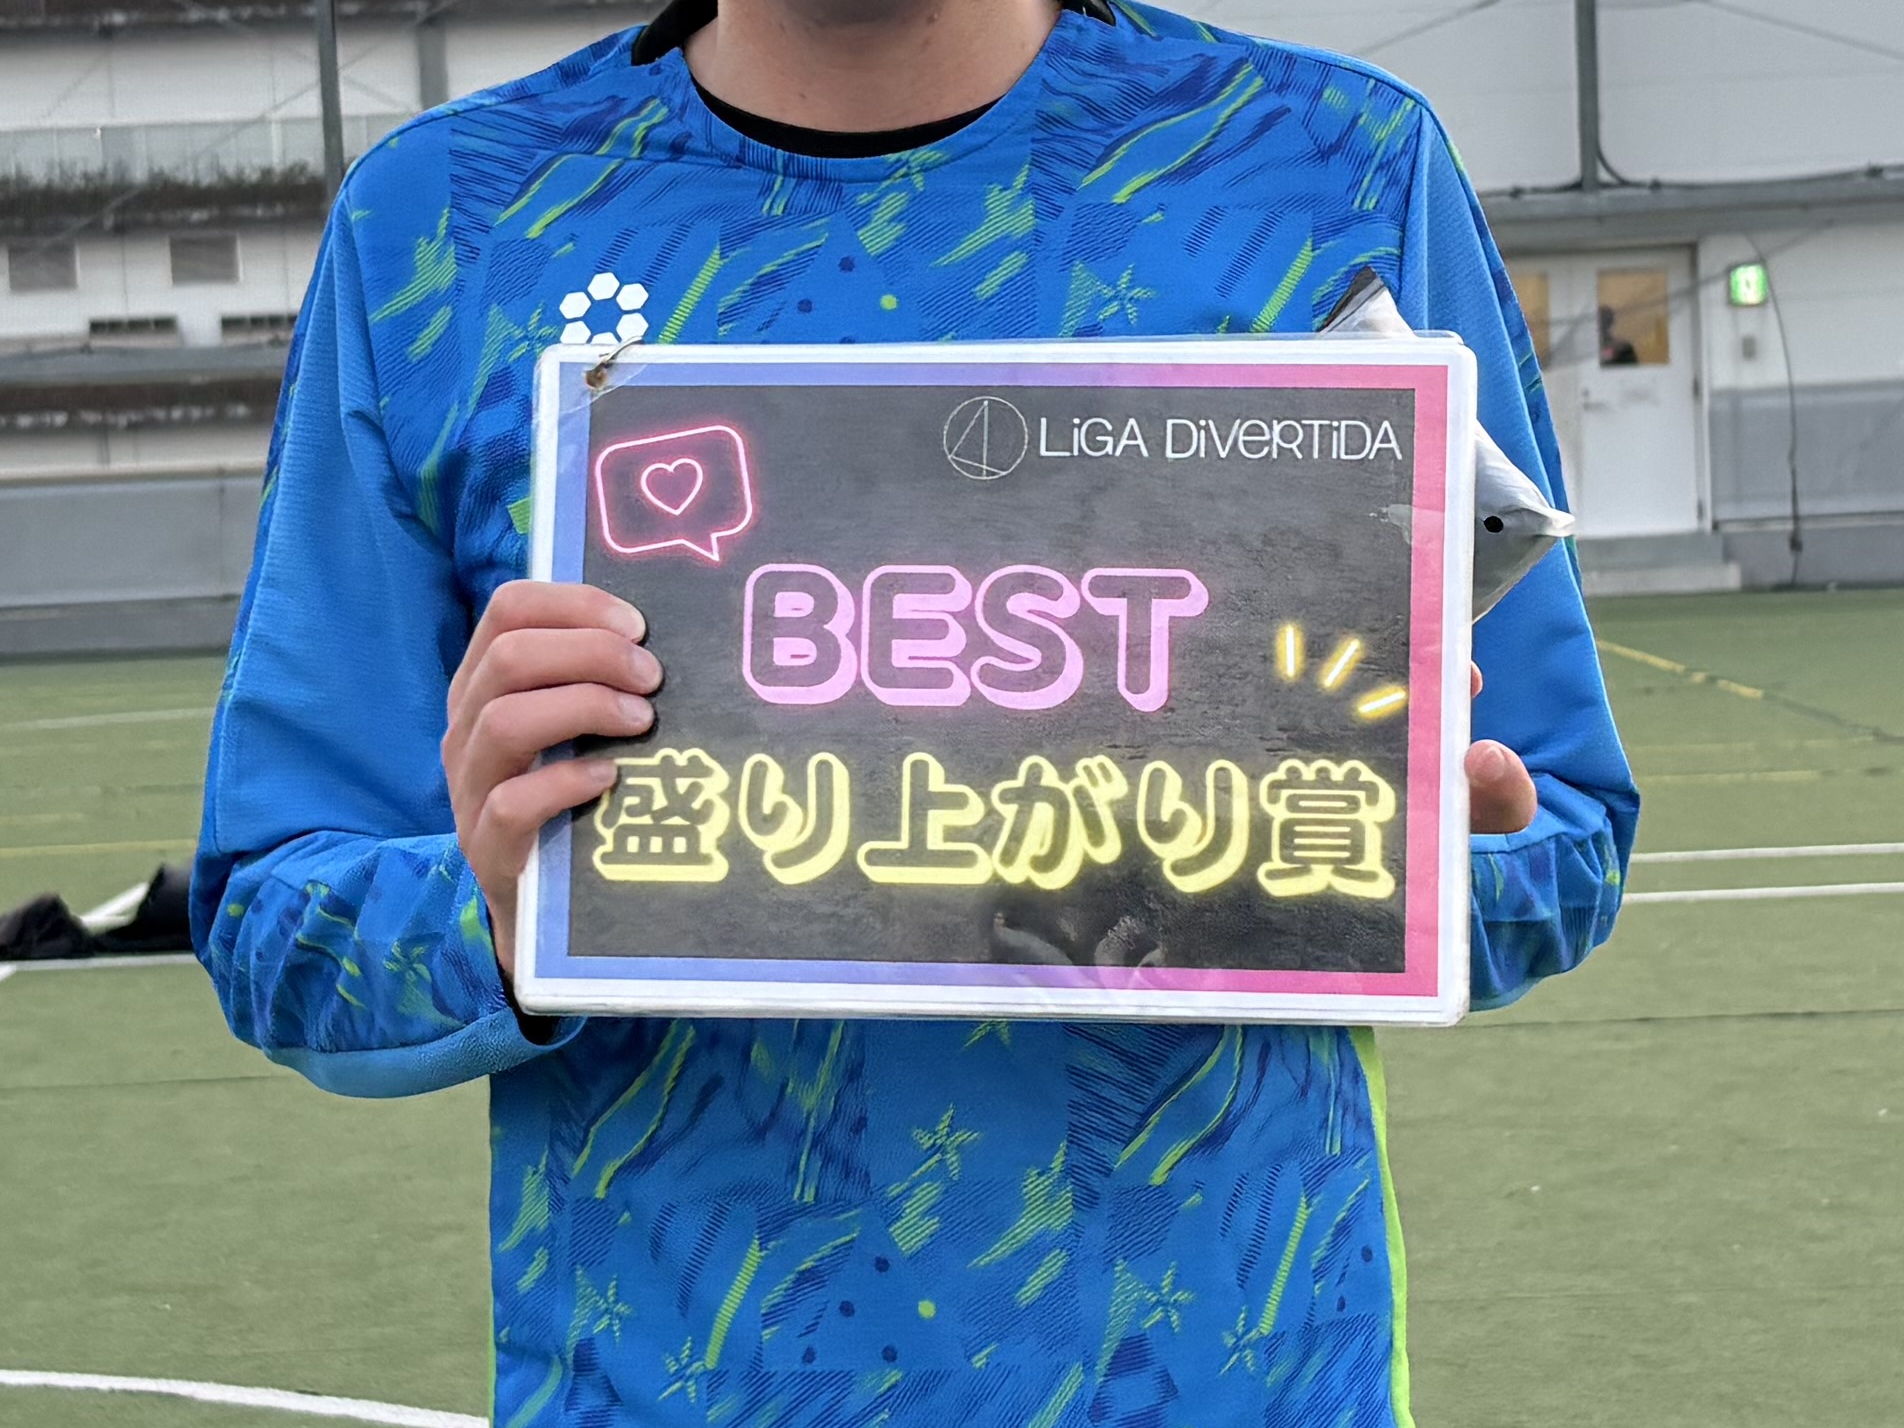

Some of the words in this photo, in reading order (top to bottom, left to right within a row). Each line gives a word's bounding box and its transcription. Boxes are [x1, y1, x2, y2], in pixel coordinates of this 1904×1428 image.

[741, 562, 1210, 713] BEST
[592, 749, 1397, 900] 盛り上がり賞
